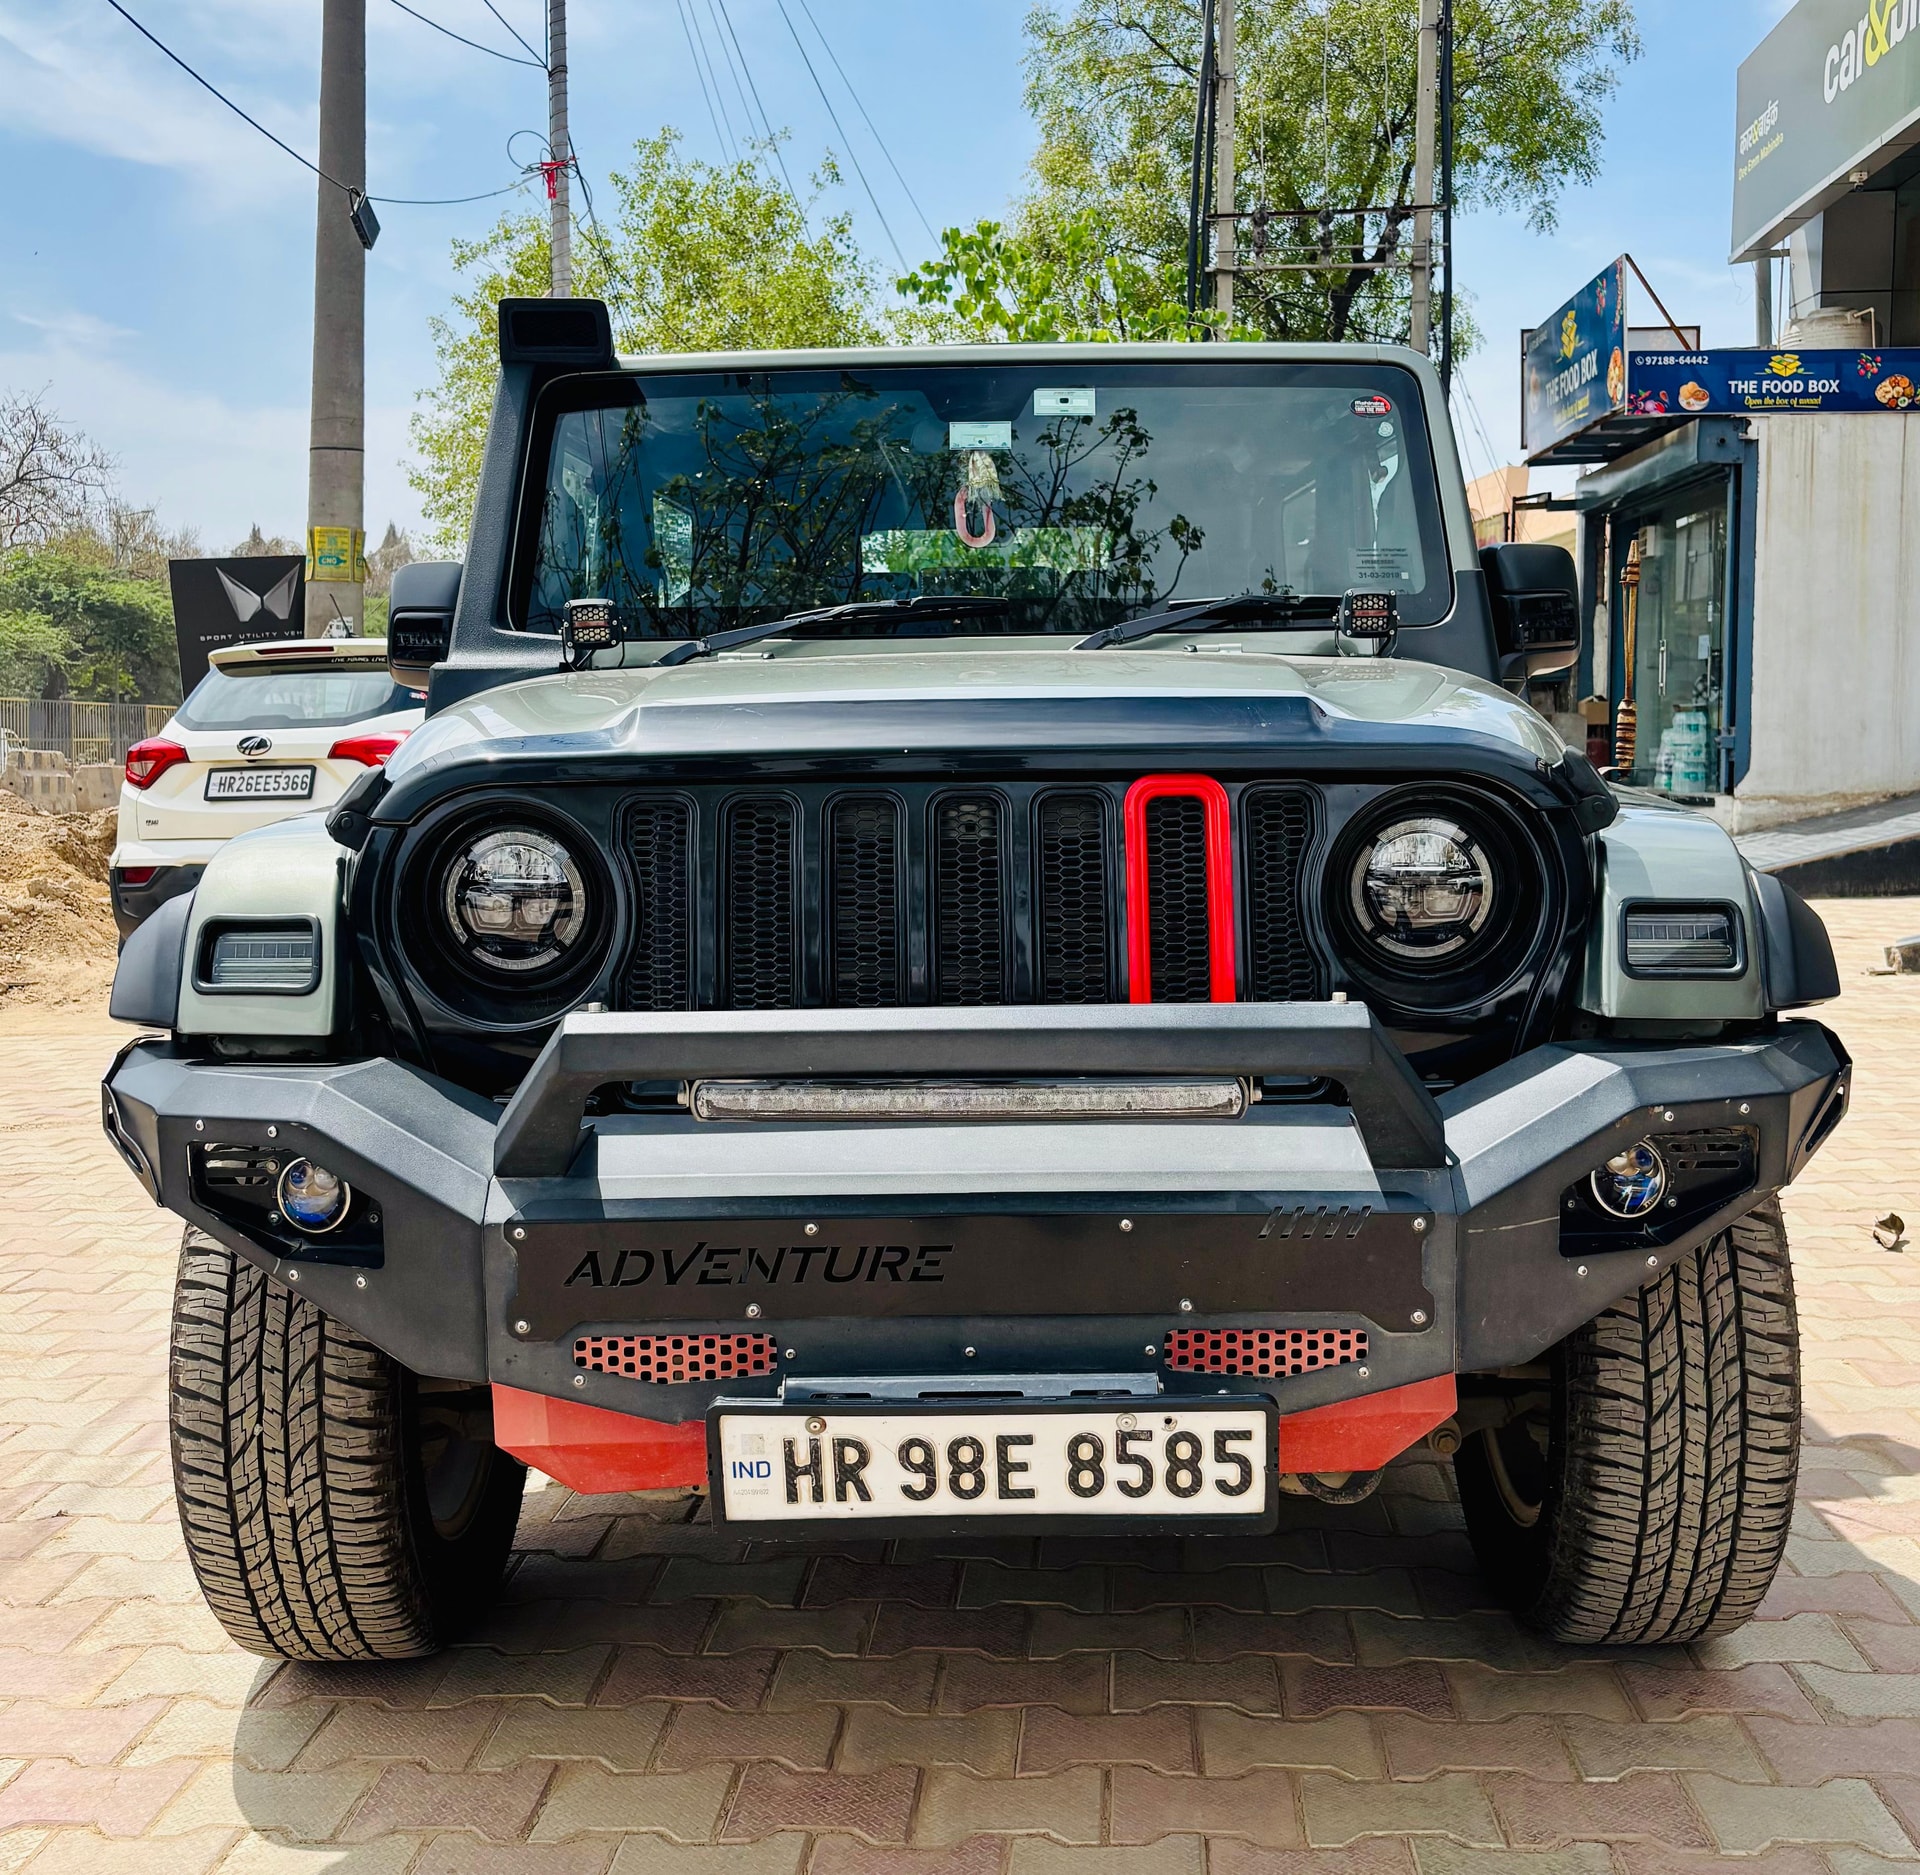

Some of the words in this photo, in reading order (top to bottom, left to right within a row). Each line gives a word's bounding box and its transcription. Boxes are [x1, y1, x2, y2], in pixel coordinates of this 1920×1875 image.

[1645, 355, 1709, 366] 97188-64442
[1545, 377, 1560, 408] THE
[1560, 362, 1580, 399] FOOD
[1581, 348, 1598, 385] BOX
[1728, 380, 1758, 394] THE
[1761, 380, 1804, 394] FOOD
[1808, 379, 1840, 393] BOX
[1744, 395, 1762, 408] Open
[1763, 395, 1775, 406] the
[1775, 395, 1789, 406] box
[199, 633, 233, 642] SPORT
[238, 631, 278, 640] UTILITY
[217, 774, 309, 793] HR26EE5366
[563, 1241, 954, 1288] ADVENTURE
[732, 1461, 771, 1479] IND
[781, 1436, 874, 1505] HR
[896, 1433, 1037, 1502] 98E
[1065, 1429, 1255, 1500] 8585
